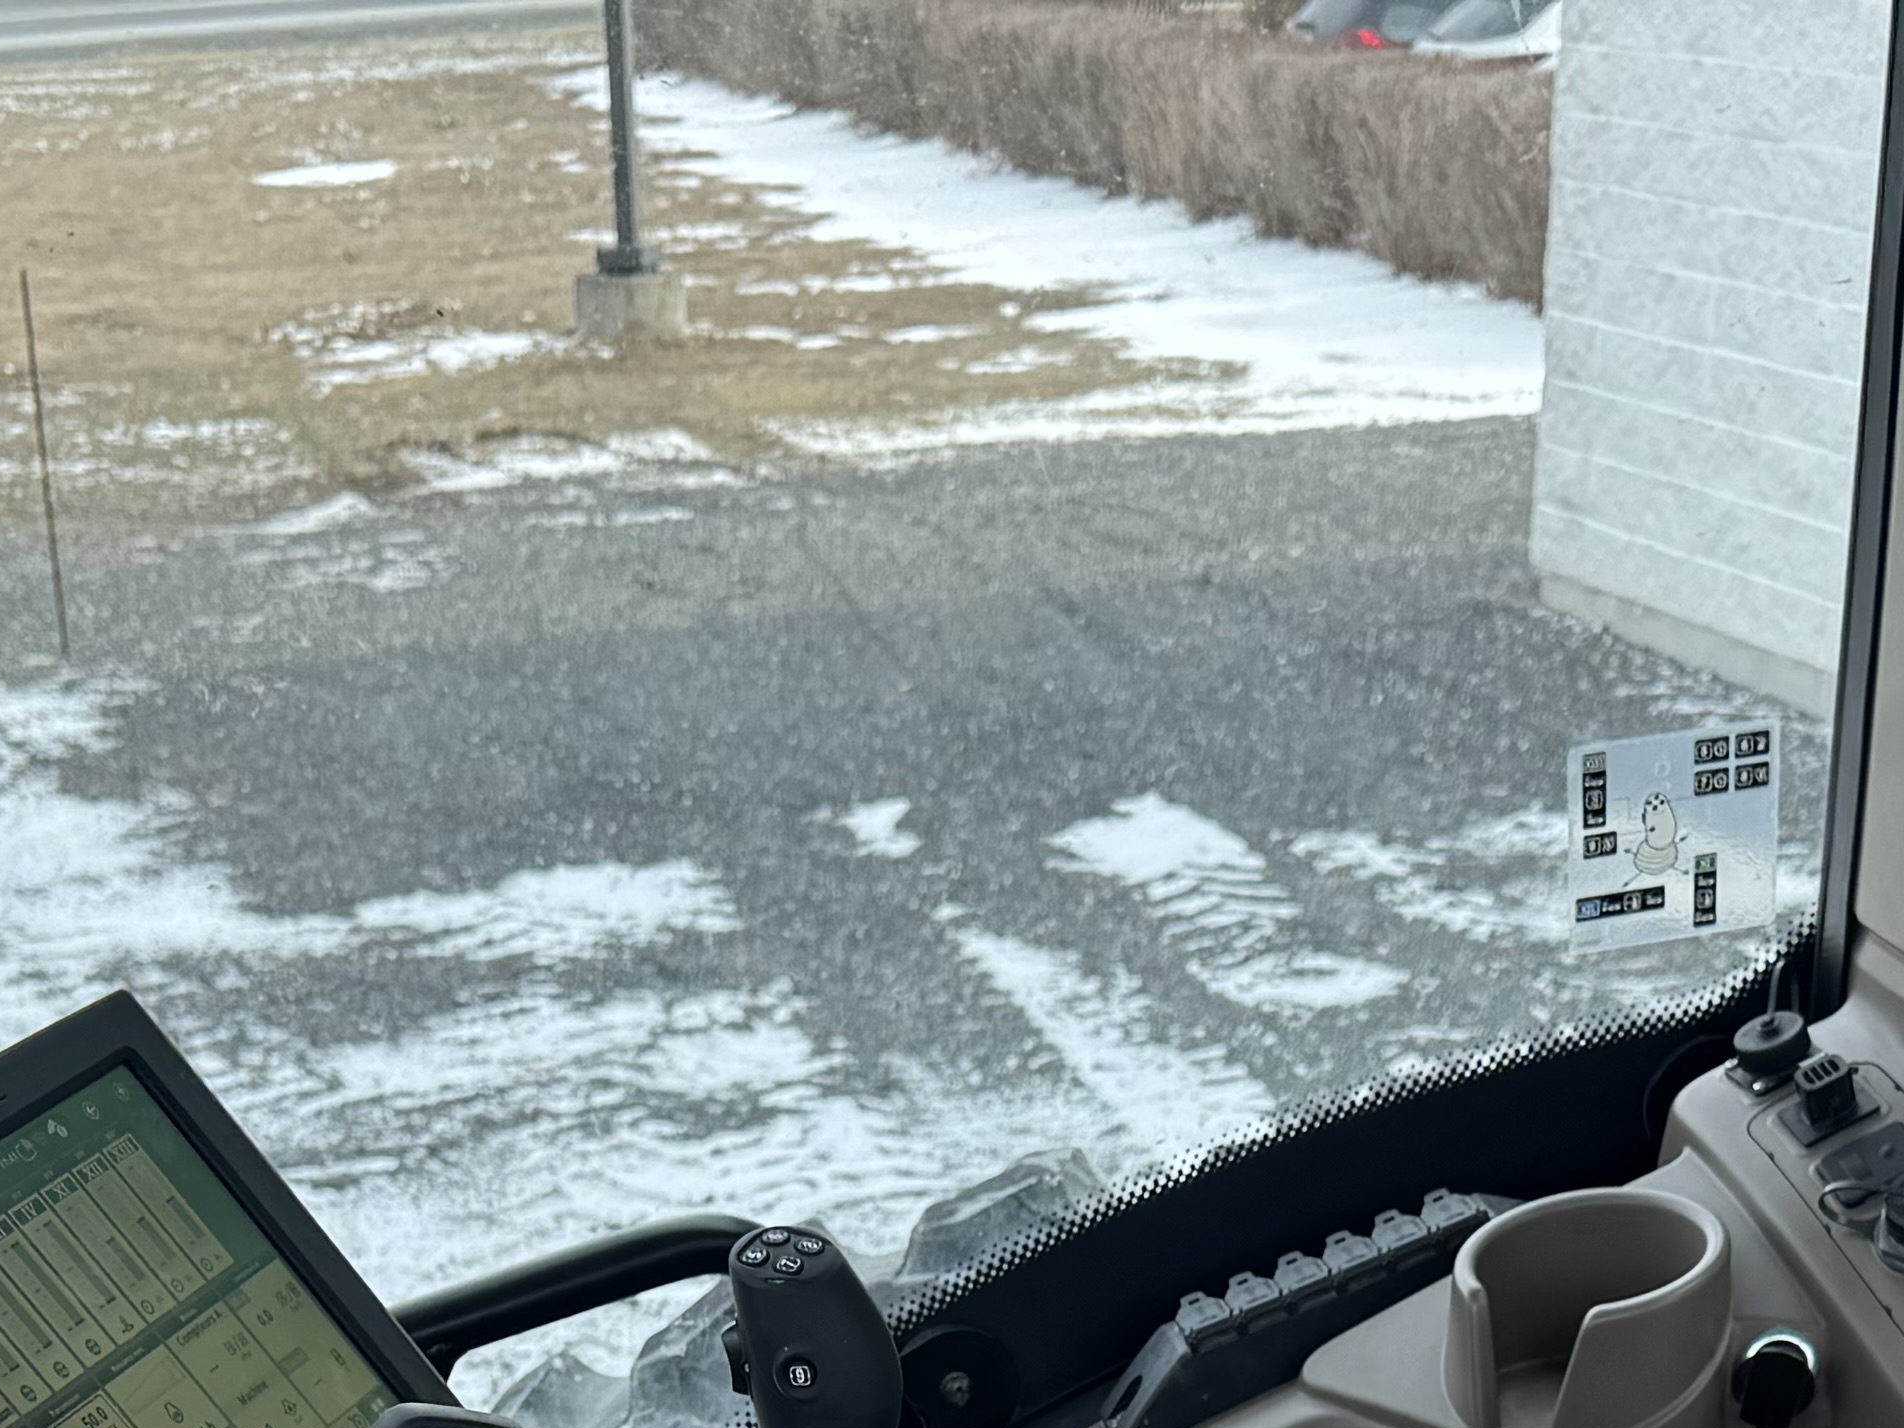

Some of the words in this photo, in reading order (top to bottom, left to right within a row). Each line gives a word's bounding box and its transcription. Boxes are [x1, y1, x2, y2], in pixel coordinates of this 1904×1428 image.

[108, 1138, 136, 1161] XIII
[81, 1160, 104, 1180] XII
[52, 1182, 71, 1199] XI
[20, 1202, 40, 1220] IV
[236, 1378, 270, 1406] Machine
